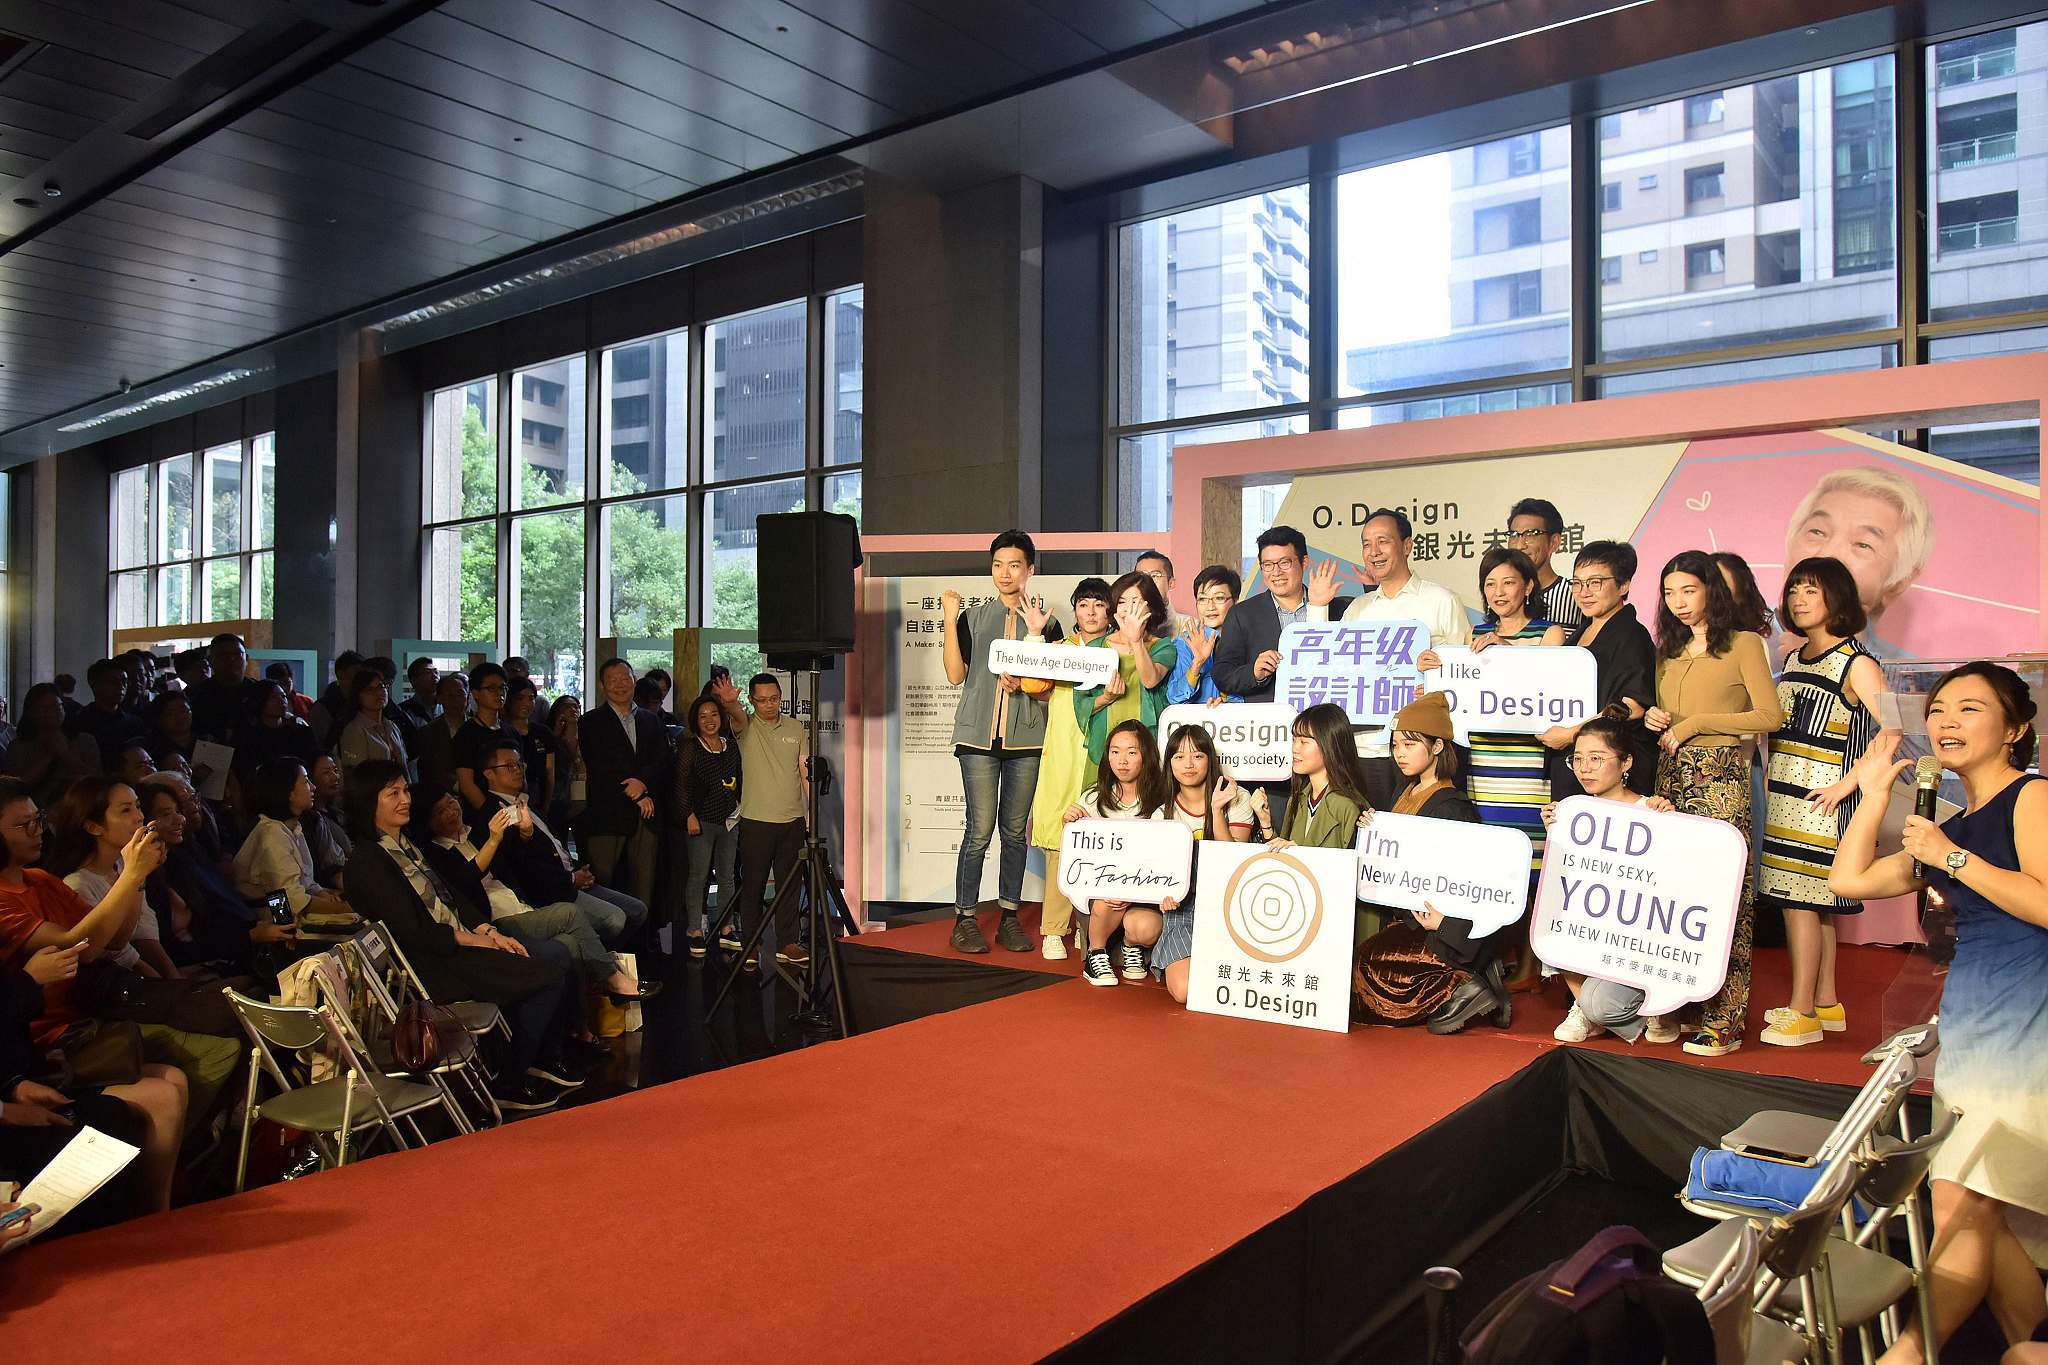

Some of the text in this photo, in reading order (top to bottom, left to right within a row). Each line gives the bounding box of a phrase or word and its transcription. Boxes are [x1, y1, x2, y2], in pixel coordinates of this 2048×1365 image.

[1312, 498, 1459, 530] O. Dsign
[1412, 523, 1586, 562] 銀光未館
[914, 640, 936, 648] Maker
[995, 650, 1110, 674] The New Age Designer
[1450, 664, 1482, 680] like
[1288, 675, 1416, 715] 設計師
[1480, 690, 1585, 723] Design
[1201, 719, 1290, 748] Design
[1243, 753, 1290, 768] society.
[904, 794, 912, 806] 3
[904, 818, 912, 830] 2
[1569, 811, 1653, 857] OLD
[1071, 831, 1124, 851] This is
[1365, 830, 1400, 859] I'm
[1094, 864, 1180, 887] Fashion
[1360, 863, 1516, 905] New Age Designer.
[1562, 853, 1658, 887] IS NEW SEXY,
[1559, 876, 1709, 943] YOUNG
[1550, 919, 1703, 967] IS NEW INTELLIGENT
[1217, 964, 1320, 991] 銀光未來館
[1216, 985, 1318, 1020] O. Design
